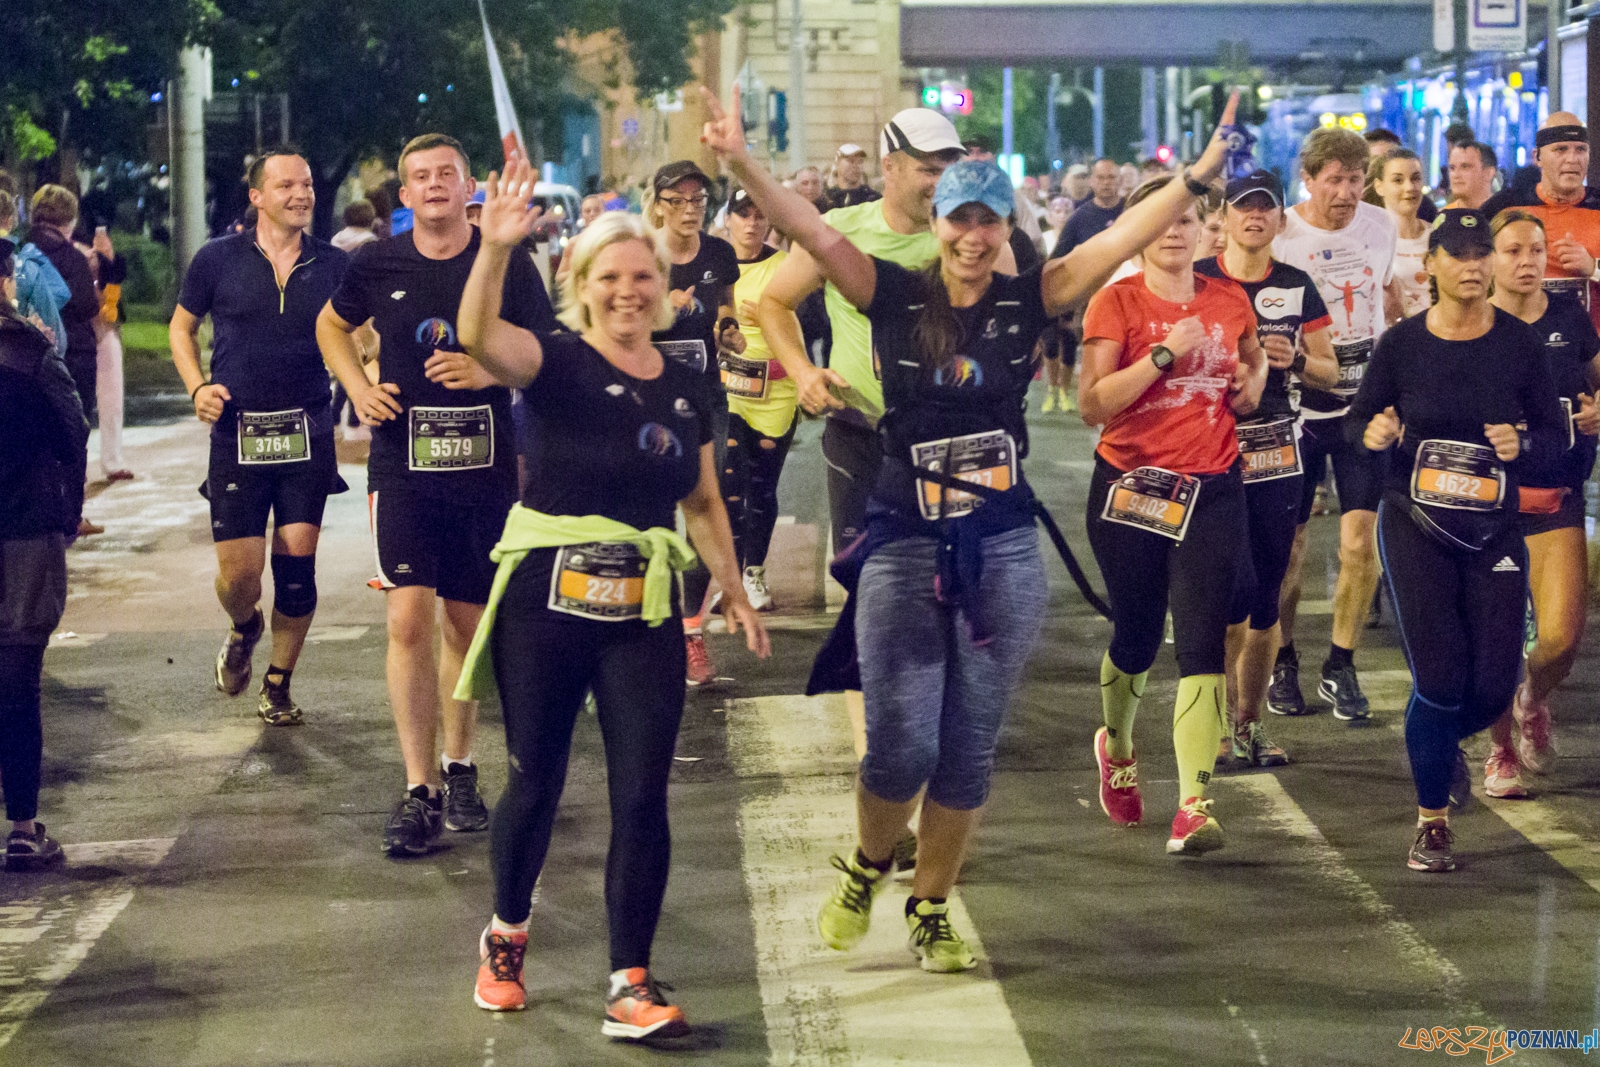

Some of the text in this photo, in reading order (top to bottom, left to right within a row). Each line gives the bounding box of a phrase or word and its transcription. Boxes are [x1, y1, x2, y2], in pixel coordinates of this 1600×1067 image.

[255, 436, 291, 453] 3764
[430, 438, 473, 457] 5579
[1248, 449, 1283, 470] 4045
[1434, 473, 1482, 498] 4622
[585, 579, 626, 603] 224
